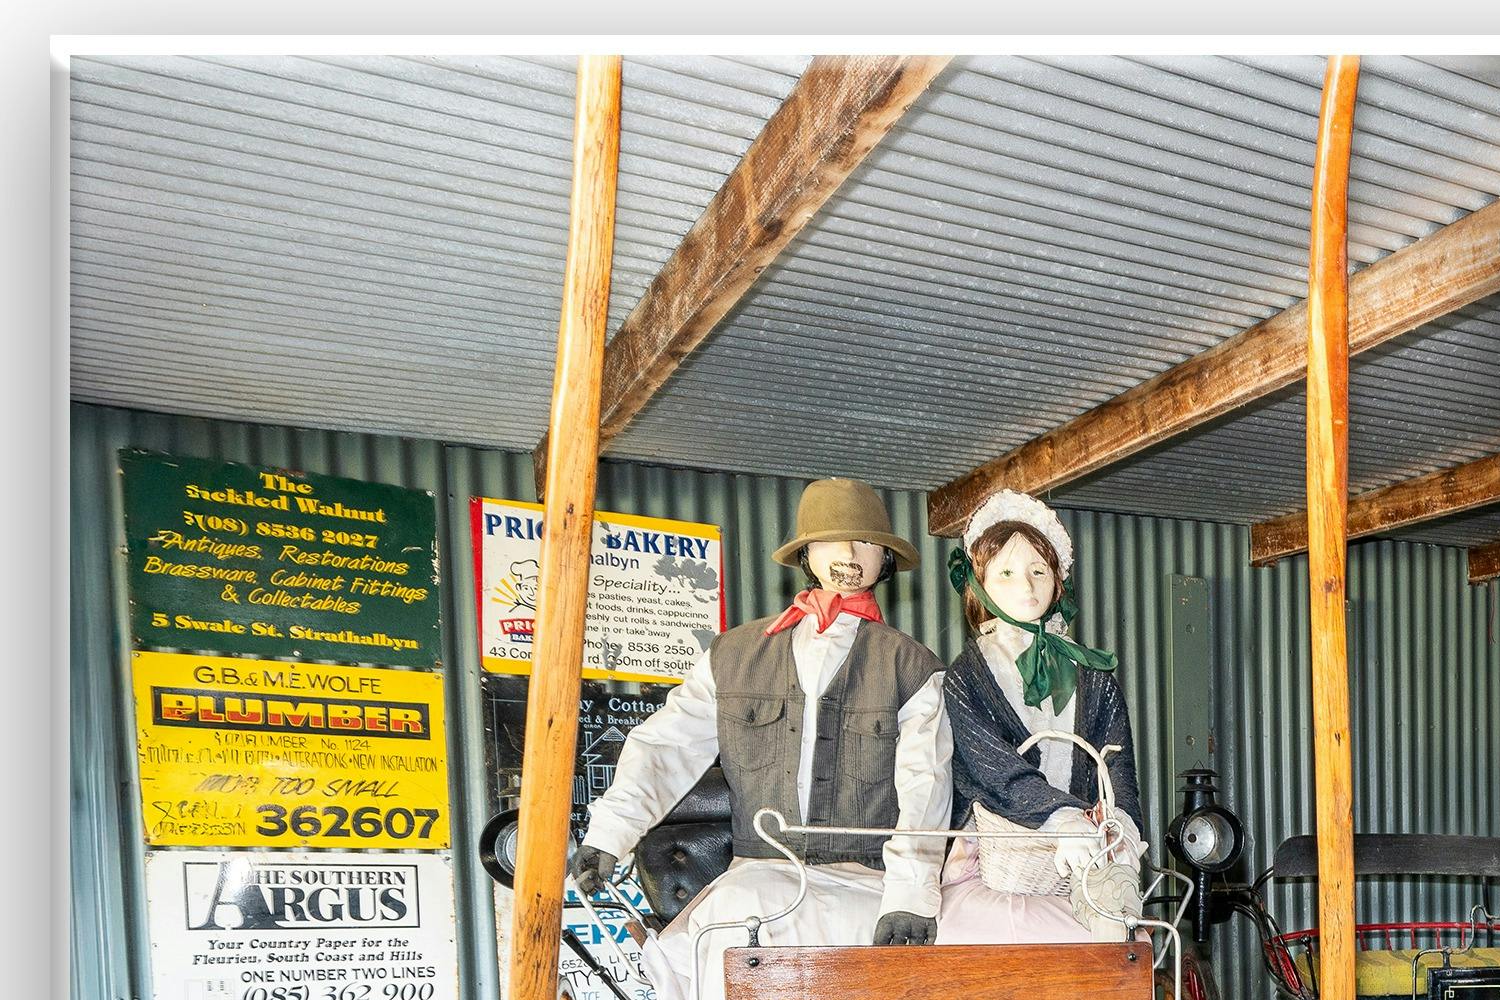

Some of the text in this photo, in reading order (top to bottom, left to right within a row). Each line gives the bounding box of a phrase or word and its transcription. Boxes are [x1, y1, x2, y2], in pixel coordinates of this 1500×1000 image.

[259, 472, 314, 495] The
[295, 495, 388, 524] Walnut
[255, 521, 315, 543] 8536
[321, 529, 380, 549] 2027
[605, 530, 710, 560] BAKERY
[278, 545, 410, 575] Restorations
[270, 569, 344, 592] Cabinet
[349, 578, 428, 604] Fittings
[220, 584, 362, 614] & Collectables
[151, 612, 420, 651] 5 Swale St. Strathalbyn
[613, 614, 628, 623] cut
[631, 616, 650, 626] rolls
[660, 619, 713, 631] sandwiches
[489, 646, 507, 658] 43
[628, 641, 660, 654] 8536
[664, 644, 695, 656] 2550
[645, 658, 661, 668] off
[307, 674, 383, 695] WOLFE
[160, 692, 425, 734] PLUMBER
[321, 738, 339, 751] No.
[345, 739, 371, 751] 1124
[380, 756, 438, 773] INSTALLATION
[322, 778, 399, 798] SMALL
[256, 803, 441, 839] 362607
[290, 870, 407, 886] SOUTHERN
[198, 861, 408, 930] ARGUS
[207, 937, 409, 951] Your Country Paper for the
[266, 951, 310, 964] South
[315, 951, 355, 963] Coast
[358, 951, 384, 962] and
[389, 951, 423, 962] Hills
[240, 966, 436, 983] ONE NUMBER TWO LINES
